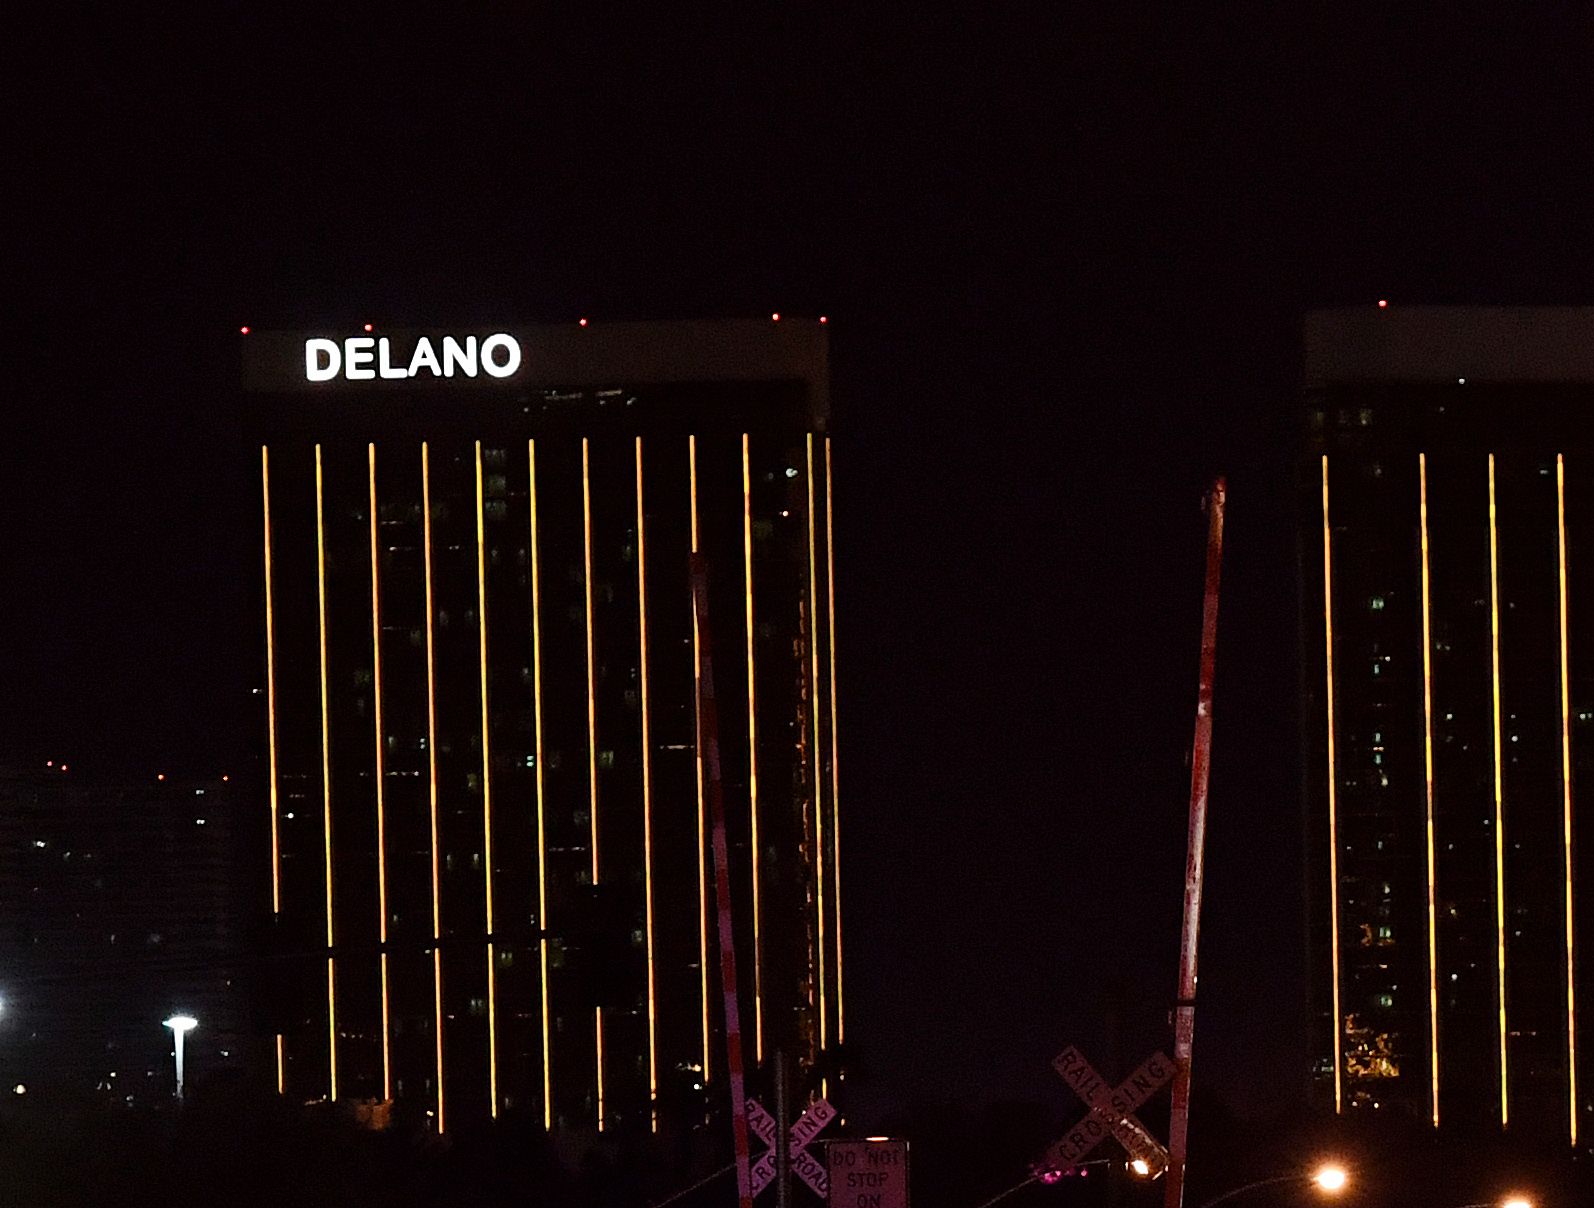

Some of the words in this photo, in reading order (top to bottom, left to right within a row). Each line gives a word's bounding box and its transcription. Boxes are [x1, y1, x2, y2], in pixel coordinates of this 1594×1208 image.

[305, 333, 522, 382] DELANO
[1057, 1051, 1101, 1101] RAIL
[1058, 1060, 1165, 1161] CROSSING
[832, 1150, 856, 1167] DO
[847, 1171, 889, 1189] STOP
